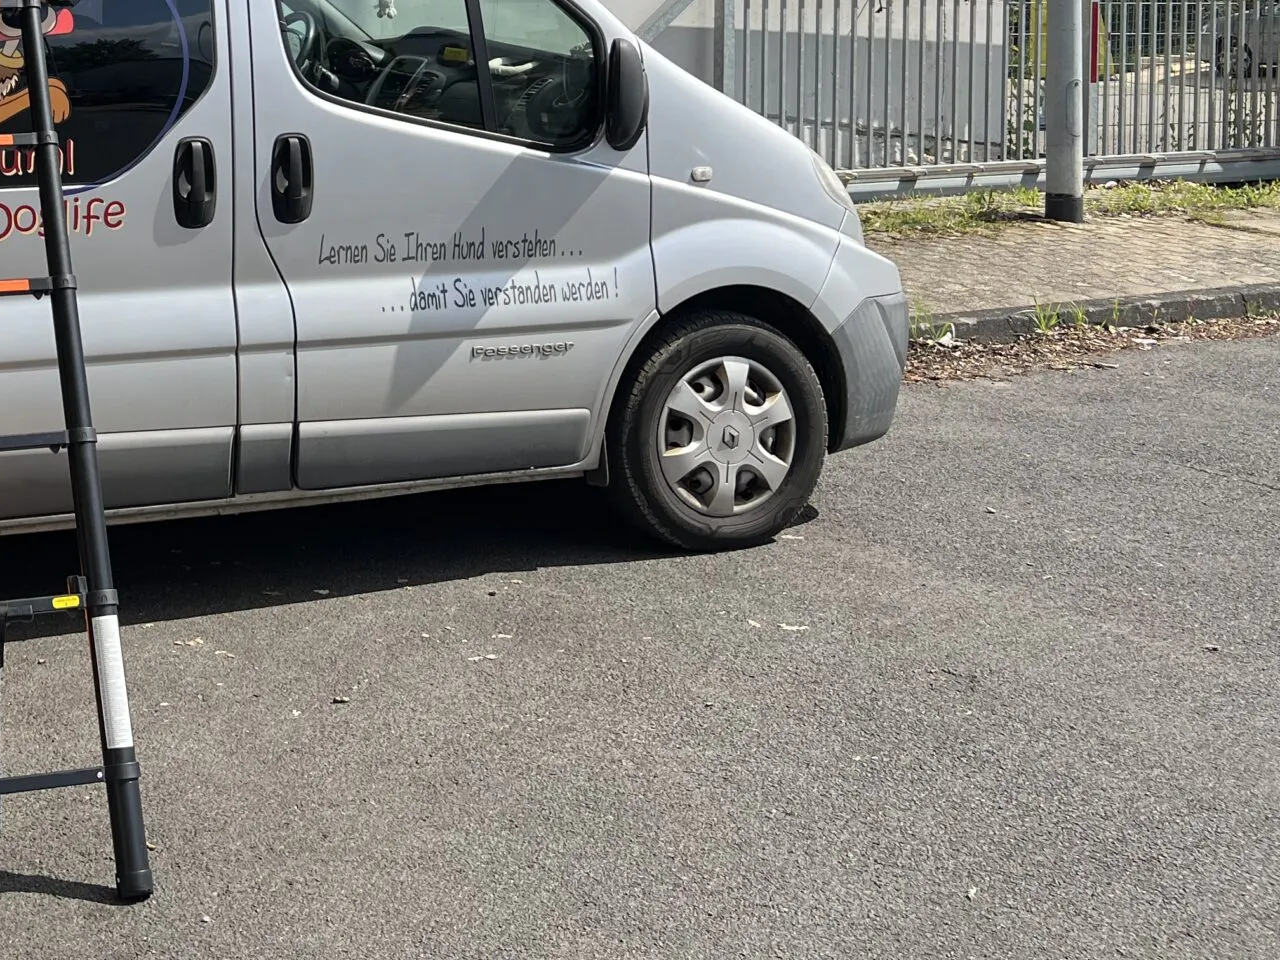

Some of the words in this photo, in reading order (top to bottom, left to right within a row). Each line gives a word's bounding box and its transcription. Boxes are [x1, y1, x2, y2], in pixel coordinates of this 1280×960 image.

[318, 233, 368, 265] Lernen
[373, 233, 397, 263] Sie
[402, 231, 447, 262] Ihren
[452, 227, 485, 261] Hund
[454, 277, 477, 309] Sie
[481, 270, 557, 307] verstanden
